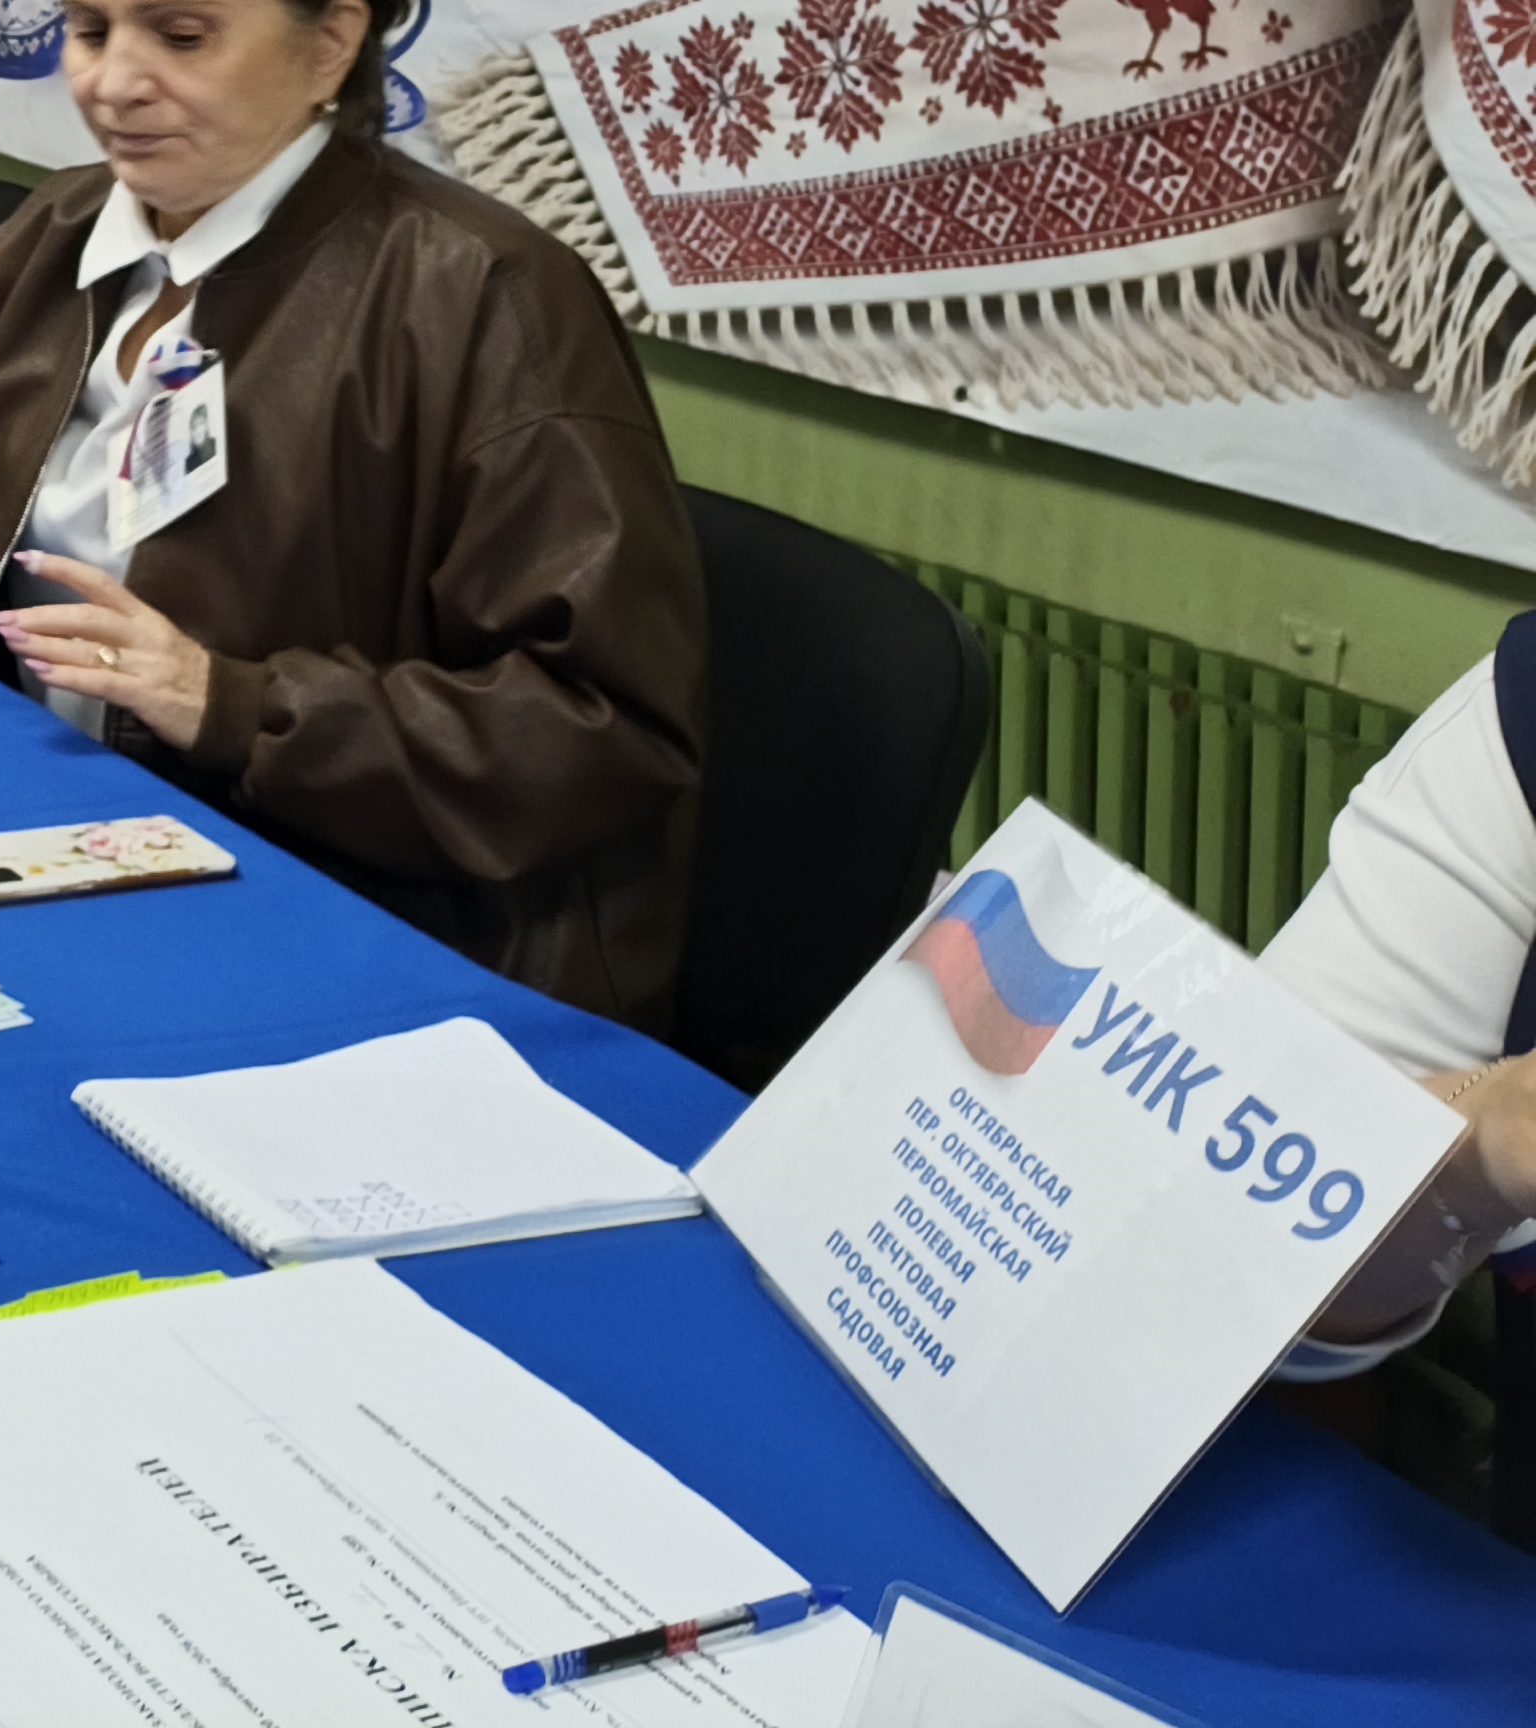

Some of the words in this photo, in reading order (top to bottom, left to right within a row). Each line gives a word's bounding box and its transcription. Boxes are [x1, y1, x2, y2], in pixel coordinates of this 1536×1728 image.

[905, 1096, 941, 1141] ПЕР.
[941, 1132, 1074, 1264] ОКТЯБРЬСКИЙ
[948, 1087, 1073, 1209] ОКТЯБРЬСКАЯ
[1072, 981, 1224, 1136] УИК
[1205, 1094, 1365, 1241] 599
[866, 1219, 958, 1321] ПЕЧТОВАЯ
[891, 1137, 1033, 1284] ПЕРВОМАЙСКАЯ
[893, 1193, 977, 1285] ПОЛЕВАЯ
[825, 1228, 957, 1378] ПРОФСОЮЗНАЯ
[826, 1285, 907, 1382] САДОВАЯ
[137, 1457, 340, 1633] ИЗБИРАТЕЛЕЙ
